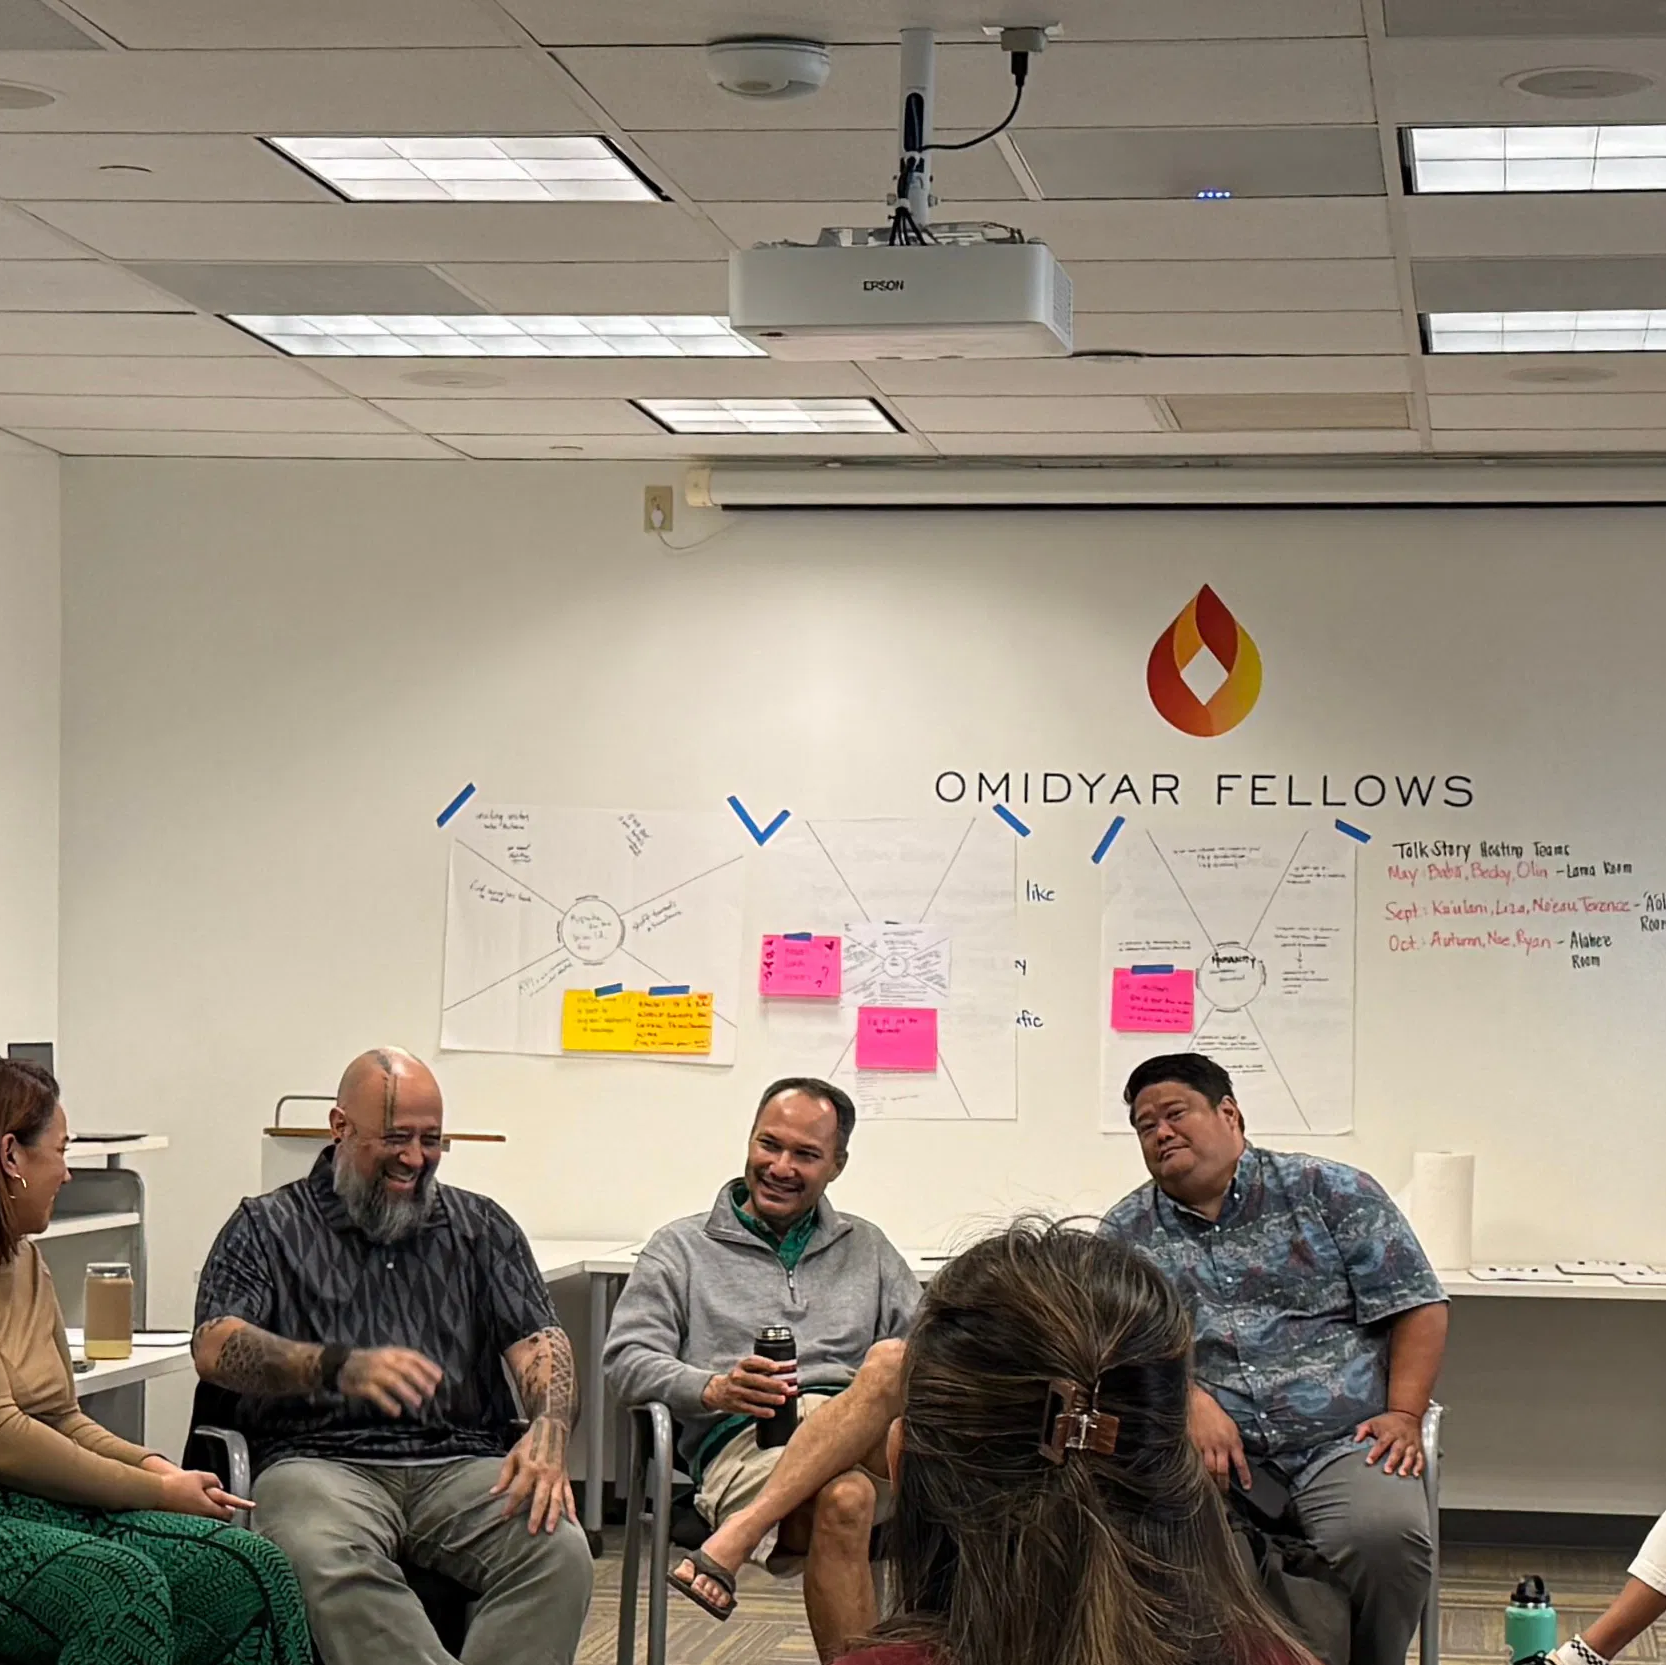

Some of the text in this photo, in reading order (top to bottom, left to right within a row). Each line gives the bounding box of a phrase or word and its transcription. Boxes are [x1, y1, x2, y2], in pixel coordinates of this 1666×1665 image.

[863, 280, 904, 292] EPSON
[936, 770, 1475, 808] OMIDYAR FELLOWS
[1392, 841, 1430, 860] Talk
[1430, 840, 1472, 864] Story
